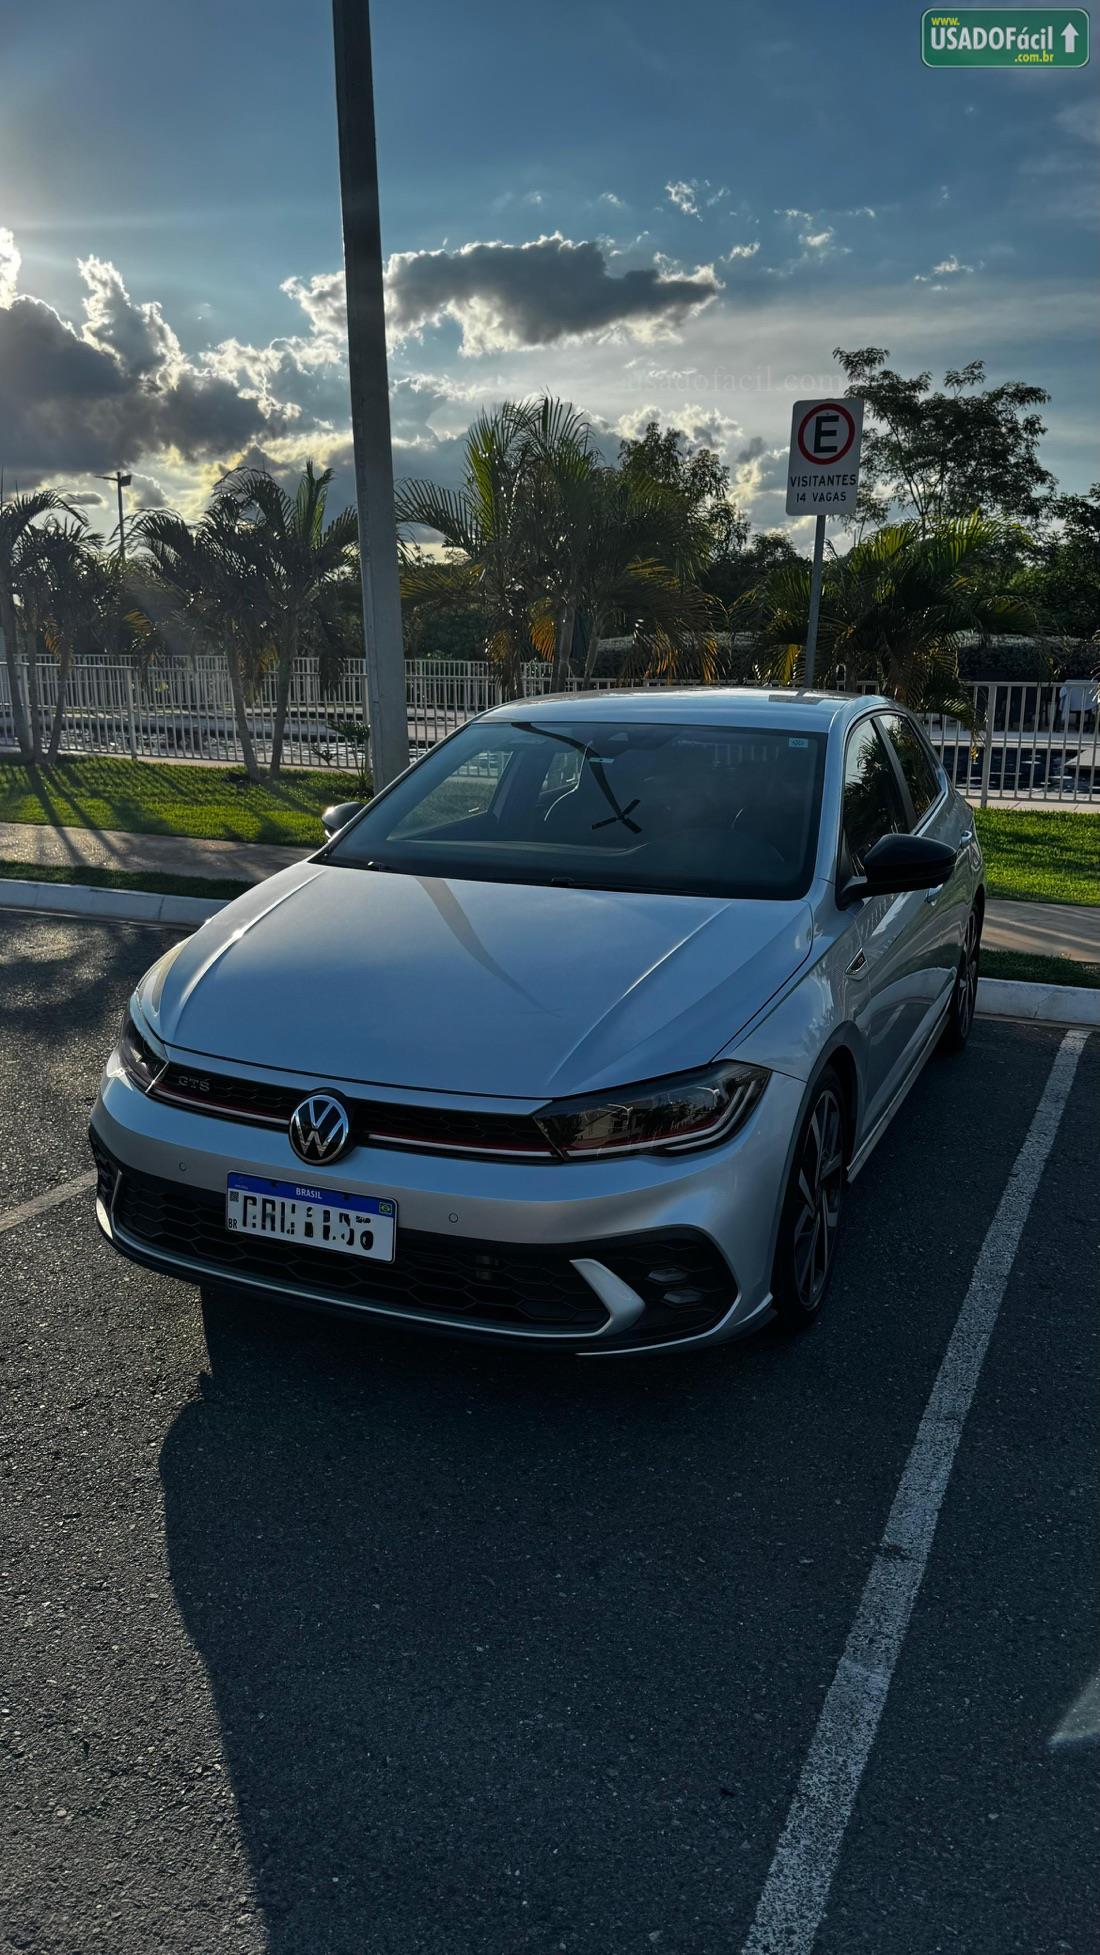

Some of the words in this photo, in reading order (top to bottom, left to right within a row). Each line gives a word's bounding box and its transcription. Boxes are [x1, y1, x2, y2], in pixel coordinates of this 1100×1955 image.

[814, 415, 840, 453] E
[790, 474, 857, 488] VISITANTES
[796, 493, 806, 503] 14
[812, 491, 847, 503] VAGAS
[177, 1075, 210, 1092] GTS
[295, 1187, 323, 1200] BRASIL
[228, 1217, 238, 1229] BR
